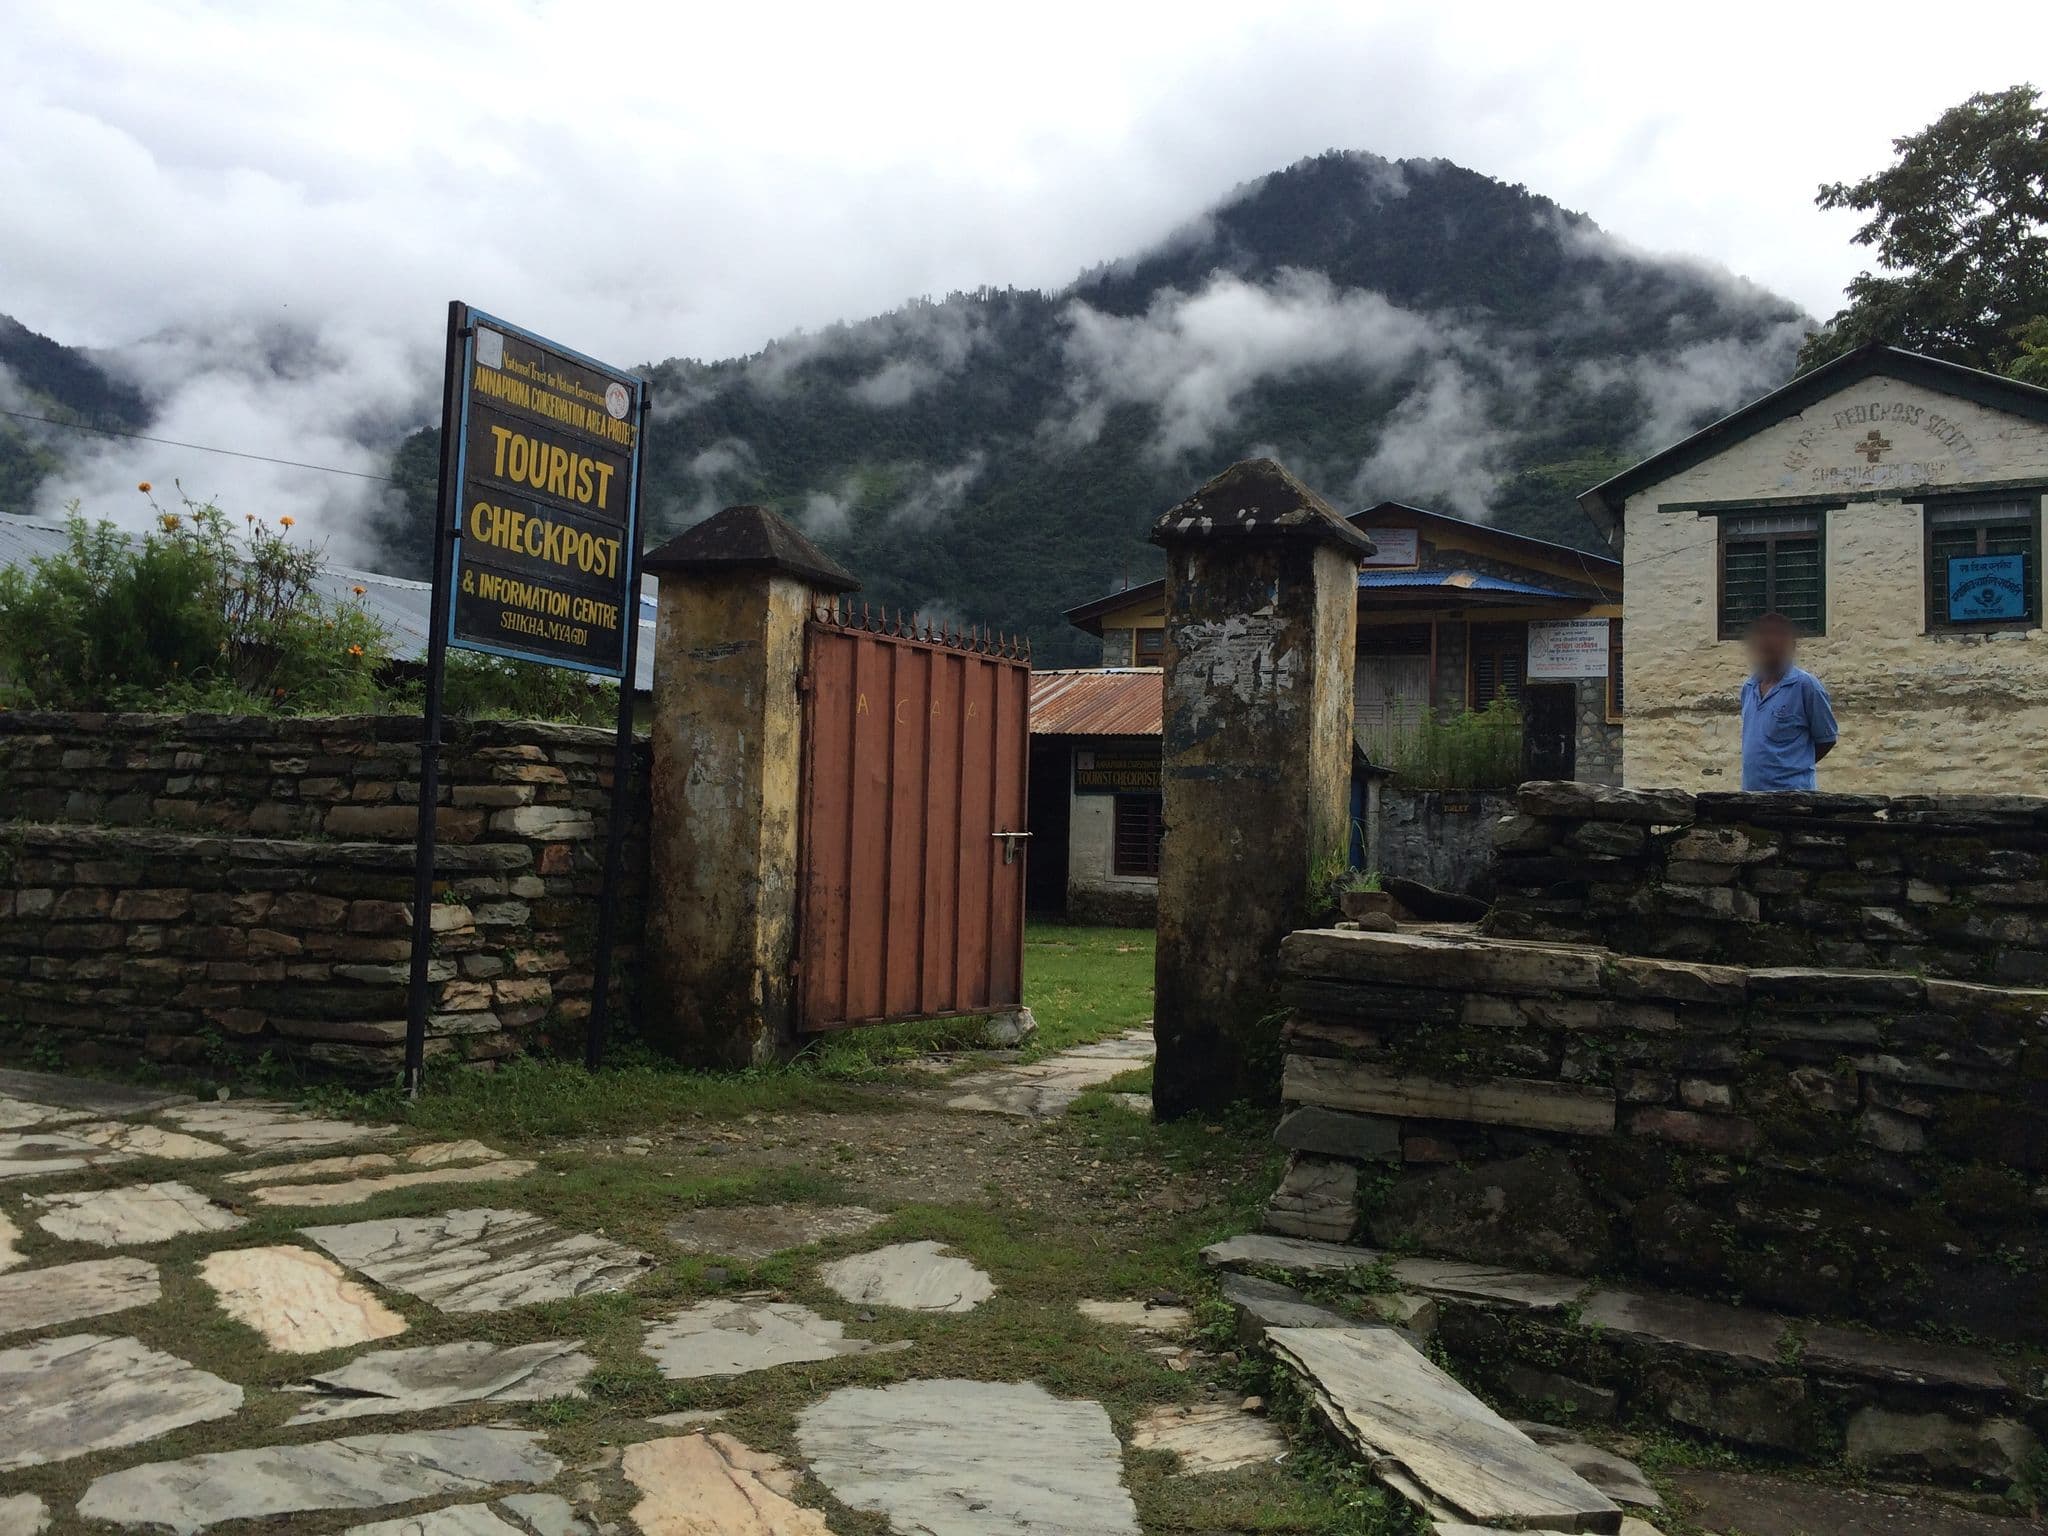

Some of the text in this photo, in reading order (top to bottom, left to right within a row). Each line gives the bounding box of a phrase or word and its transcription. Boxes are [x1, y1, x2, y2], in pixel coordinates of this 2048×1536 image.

[474, 367, 530, 408] ANNAPURNA
[531, 386, 585, 430] CONSERVATION
[585, 408, 607, 438] AREA
[503, 351, 530, 378] National
[529, 361, 546, 384] Trust
[556, 372, 575, 395] Nature
[491, 425, 614, 509] TOURIST
[471, 502, 620, 579] CHECKPOST
[462, 569, 619, 630] & INFORMATION CENTRE
[1077, 771, 1112, 785] TOURIST
